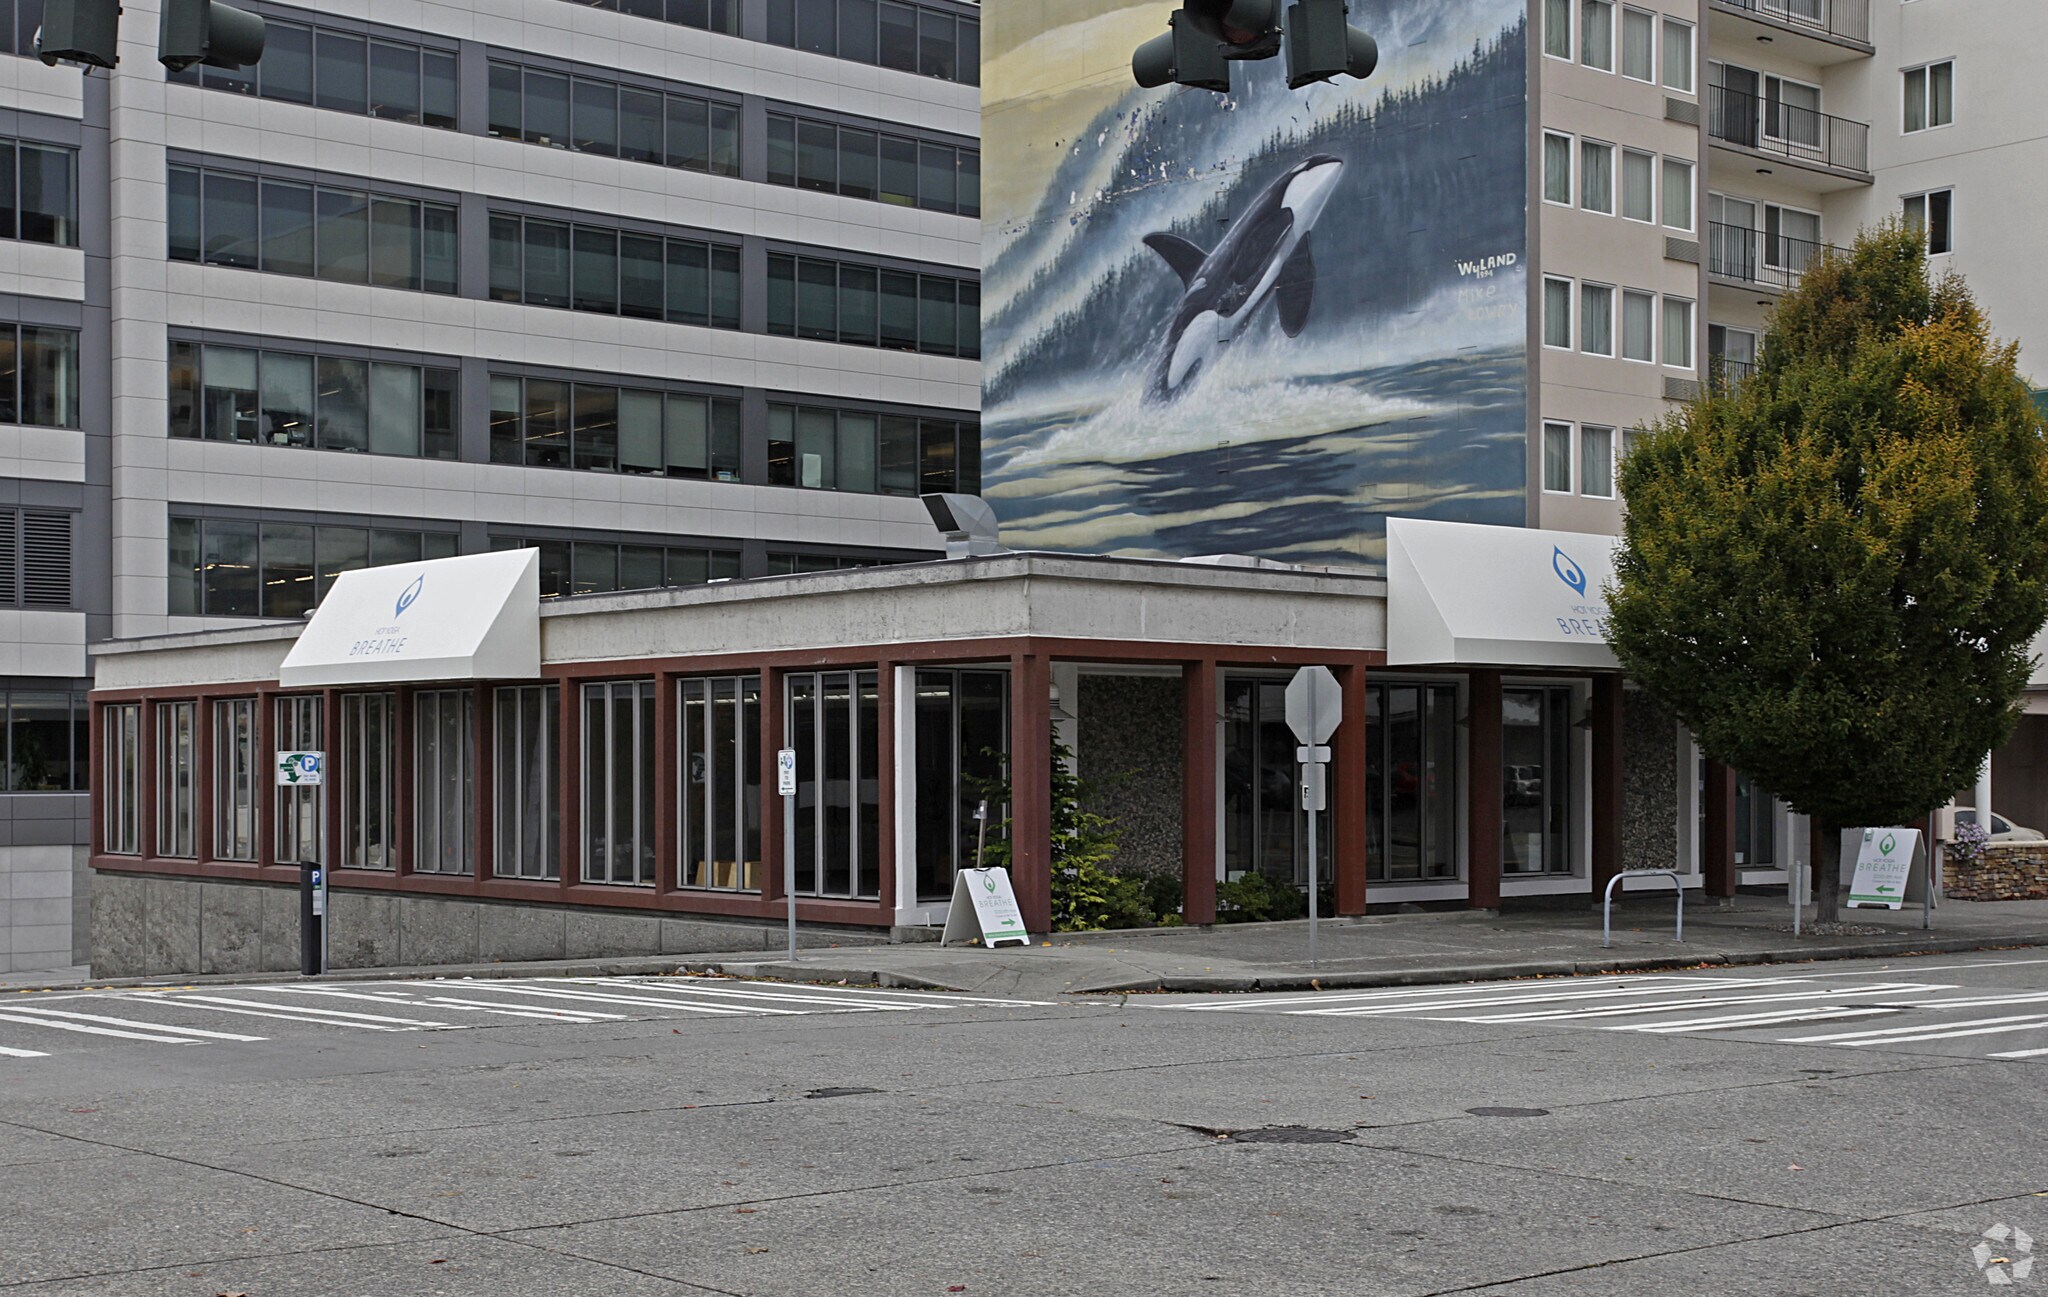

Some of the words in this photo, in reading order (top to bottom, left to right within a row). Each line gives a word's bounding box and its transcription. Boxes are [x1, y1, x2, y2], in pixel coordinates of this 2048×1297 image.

[349, 637, 407, 656] BREATHE
[304, 757, 316, 770] P
[1858, 863, 1906, 872] BREATHE
[312, 871, 320, 882] P
[978, 899, 1012, 908] BREATHE
